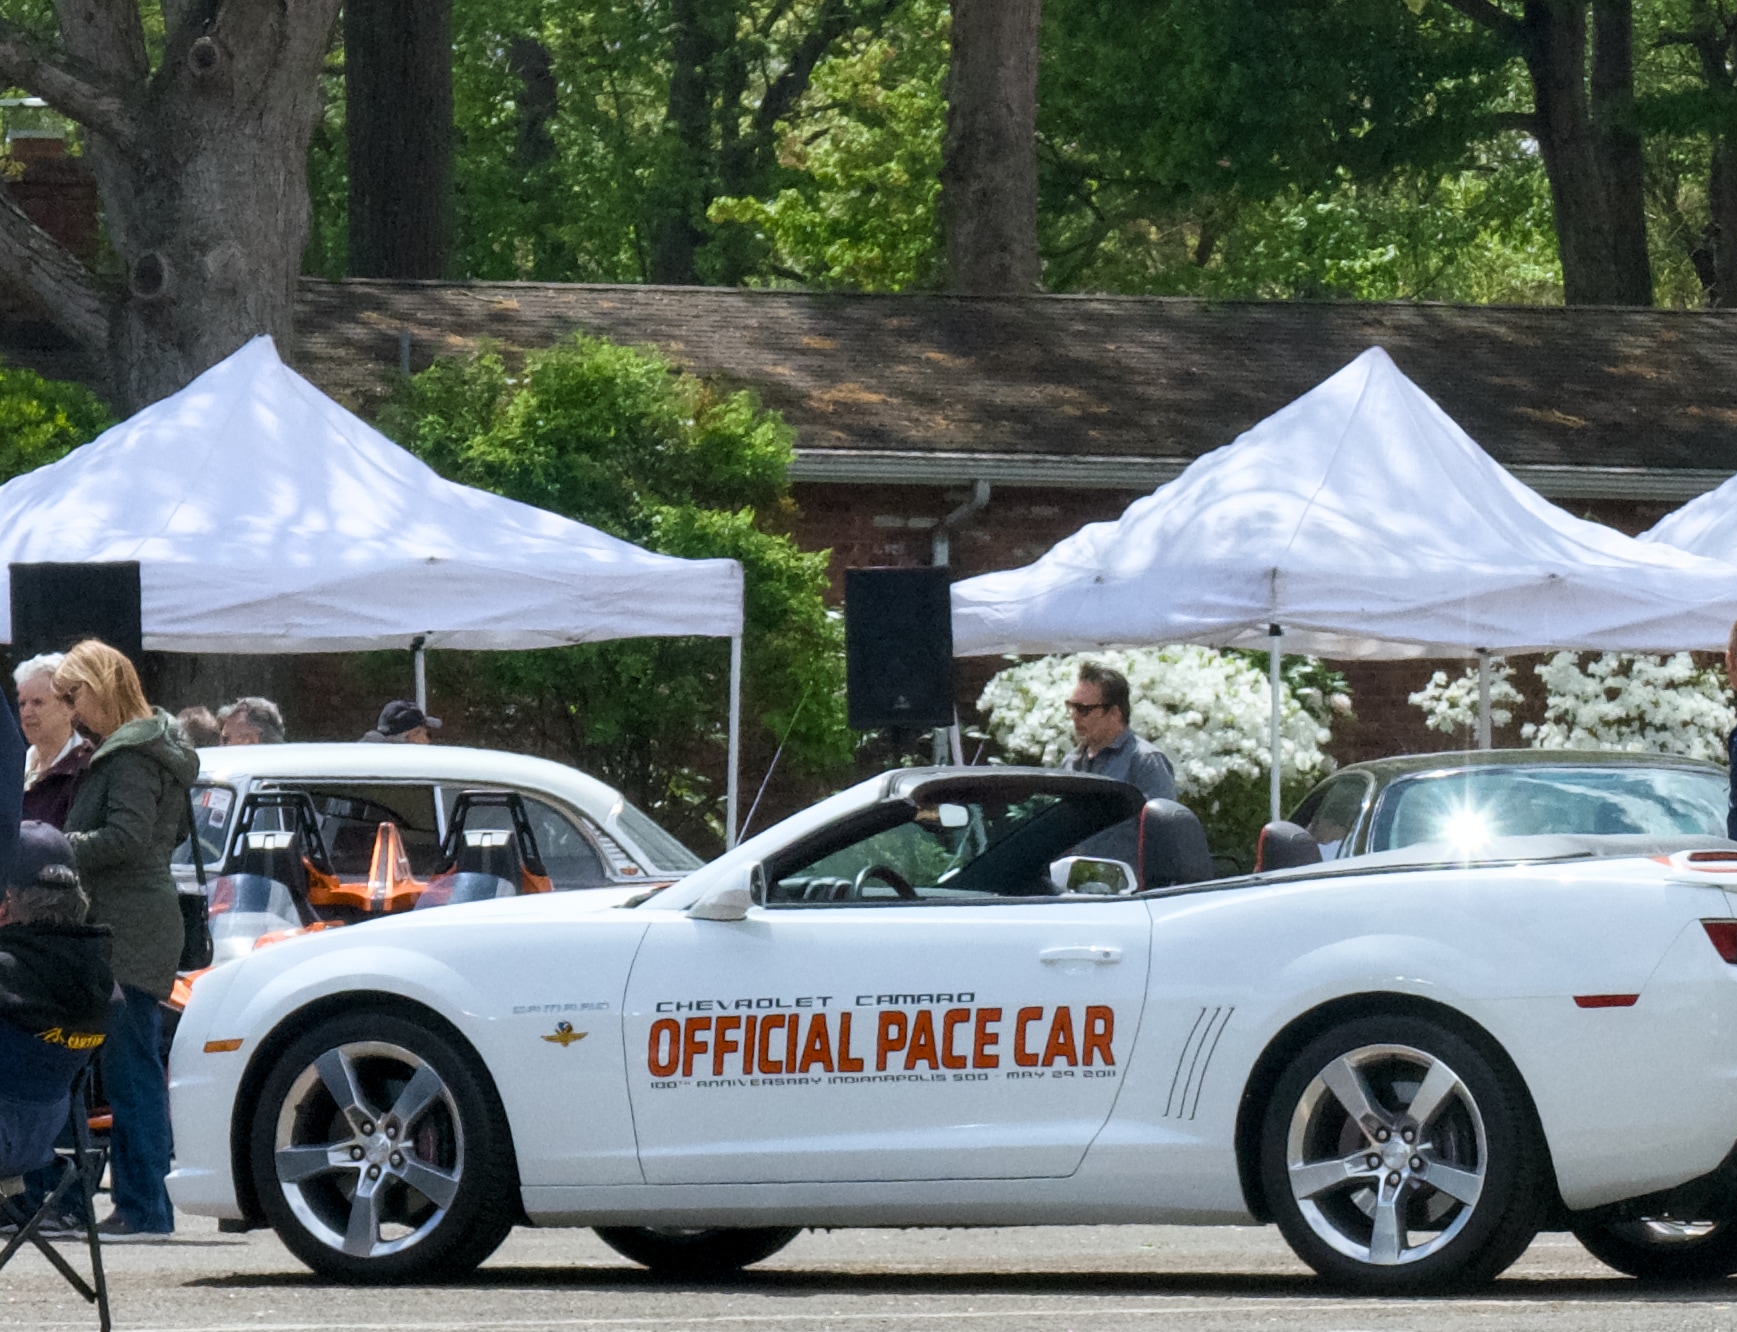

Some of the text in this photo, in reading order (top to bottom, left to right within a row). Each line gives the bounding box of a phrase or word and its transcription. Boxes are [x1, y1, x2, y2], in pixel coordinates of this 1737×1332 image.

[656, 992, 975, 1013] CHEVROLET CAMARO
[647, 1005, 1116, 1077] OFFICIAL PACE CAR
[697, 1077, 822, 1088] ANNIVERSARY
[828, 1073, 947, 1085] INDIANAPOLIS
[953, 1072, 988, 1082] 500
[1006, 1070, 1045, 1080] MAY
[1052, 1070, 1075, 1079] 29
[1082, 1069, 1116, 1079] 2011
